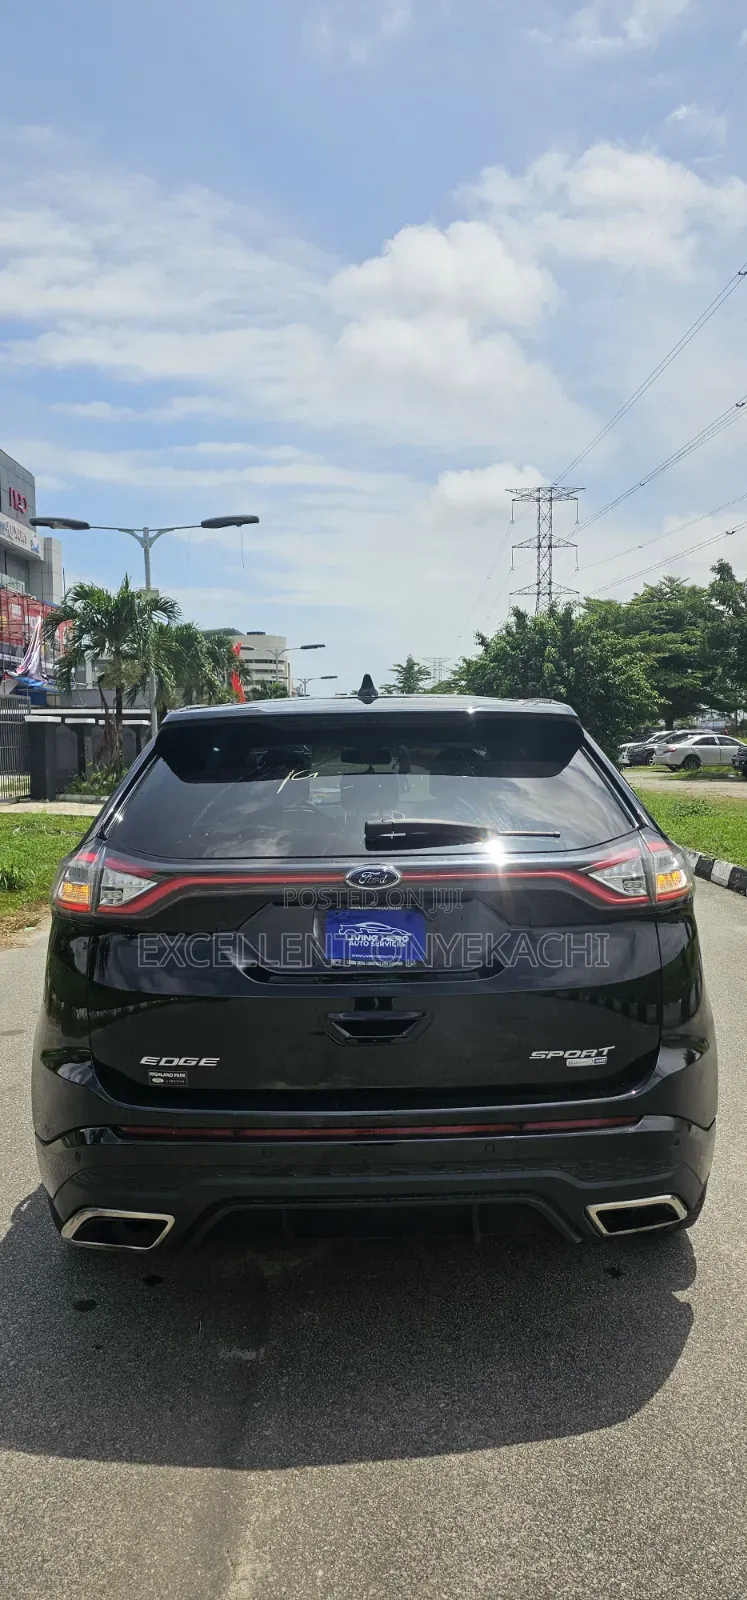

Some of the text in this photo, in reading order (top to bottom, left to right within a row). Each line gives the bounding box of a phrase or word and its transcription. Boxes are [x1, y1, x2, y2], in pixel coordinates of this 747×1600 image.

[358, 871, 388, 885] Ford
[346, 934, 378, 942] LIVING
[529, 1046, 615, 1059] SPORT
[140, 1056, 220, 1067] EDGE
